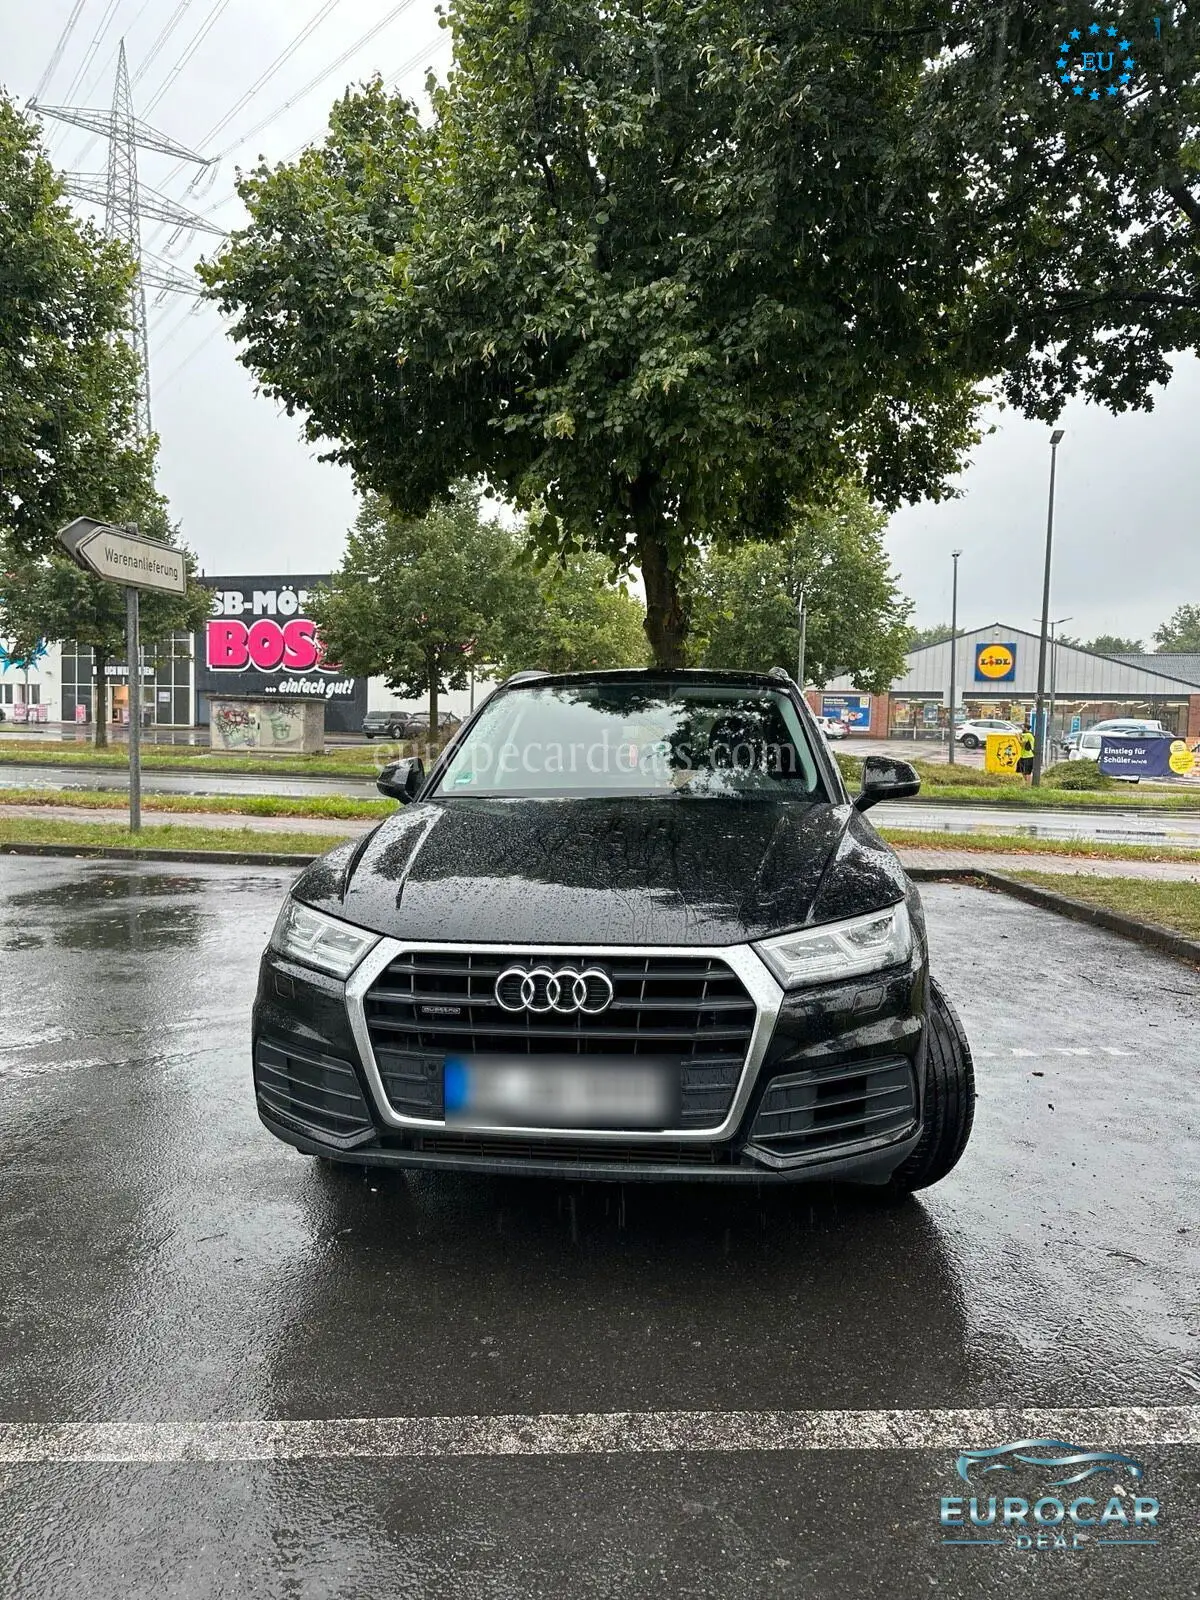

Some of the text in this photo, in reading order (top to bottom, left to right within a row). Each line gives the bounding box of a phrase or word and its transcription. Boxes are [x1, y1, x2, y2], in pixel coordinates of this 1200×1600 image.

[104, 547, 178, 581] Warenanlieferung
[206, 619, 343, 674] BOS
[278, 677, 325, 694] einfach
[325, 678, 355, 699] gut!
[1103, 756, 1131, 764] Schüler
[1104, 747, 1146, 756] Einstieg für
